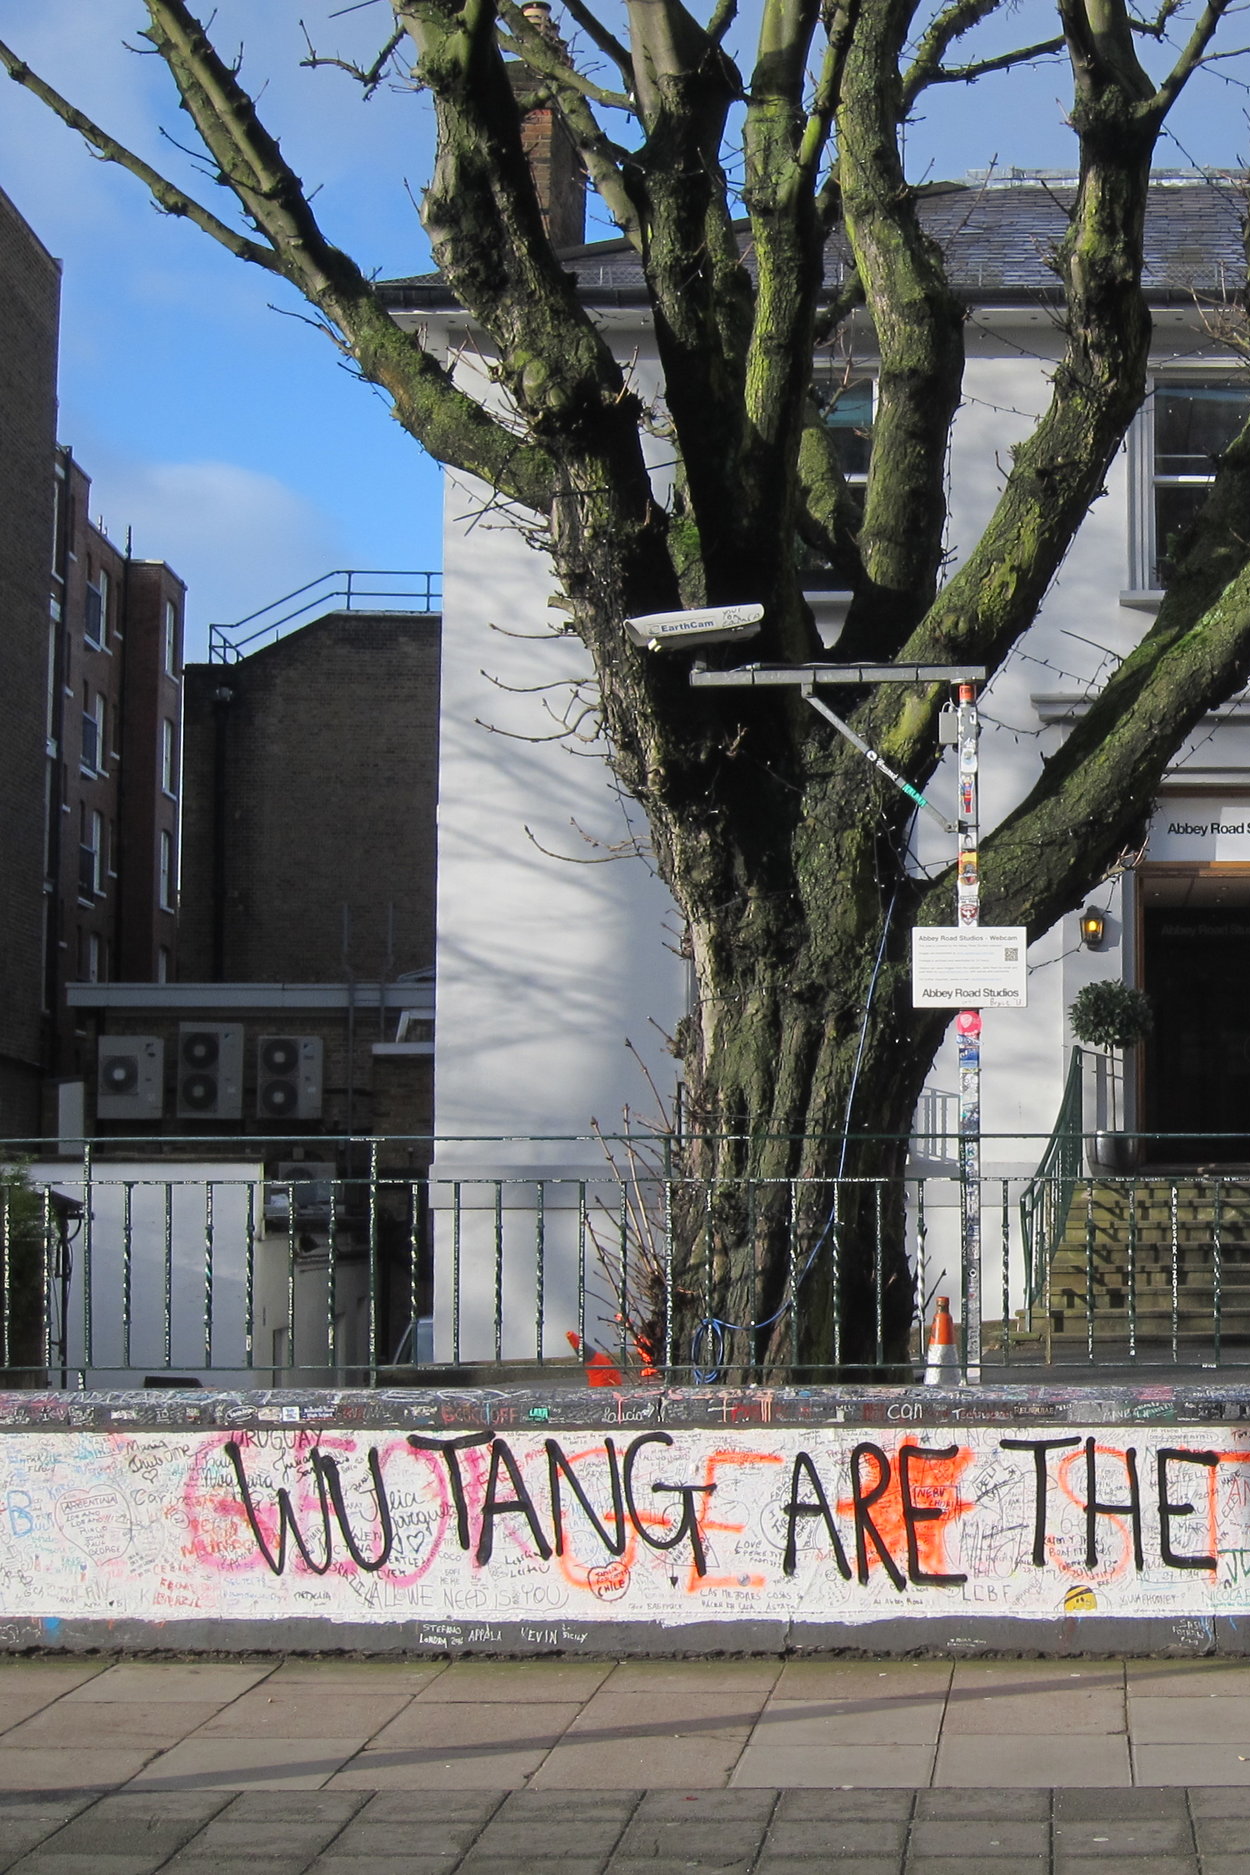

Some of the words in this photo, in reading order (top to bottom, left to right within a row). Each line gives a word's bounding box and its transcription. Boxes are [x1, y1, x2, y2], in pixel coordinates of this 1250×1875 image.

[661, 619, 715, 633] EarthCam
[1167, 822, 1207, 837] Abbey
[1210, 822, 1244, 834] Road
[1161, 924, 1197, 938] Abbey
[922, 988, 953, 999] Abbey
[954, 988, 981, 998] Road
[983, 988, 1019, 998] Studios
[225, 1440, 394, 1576] WU
[407, 1431, 717, 1577] TANG
[784, 1442, 968, 1592] ARE
[1000, 1436, 1220, 1571] THE
